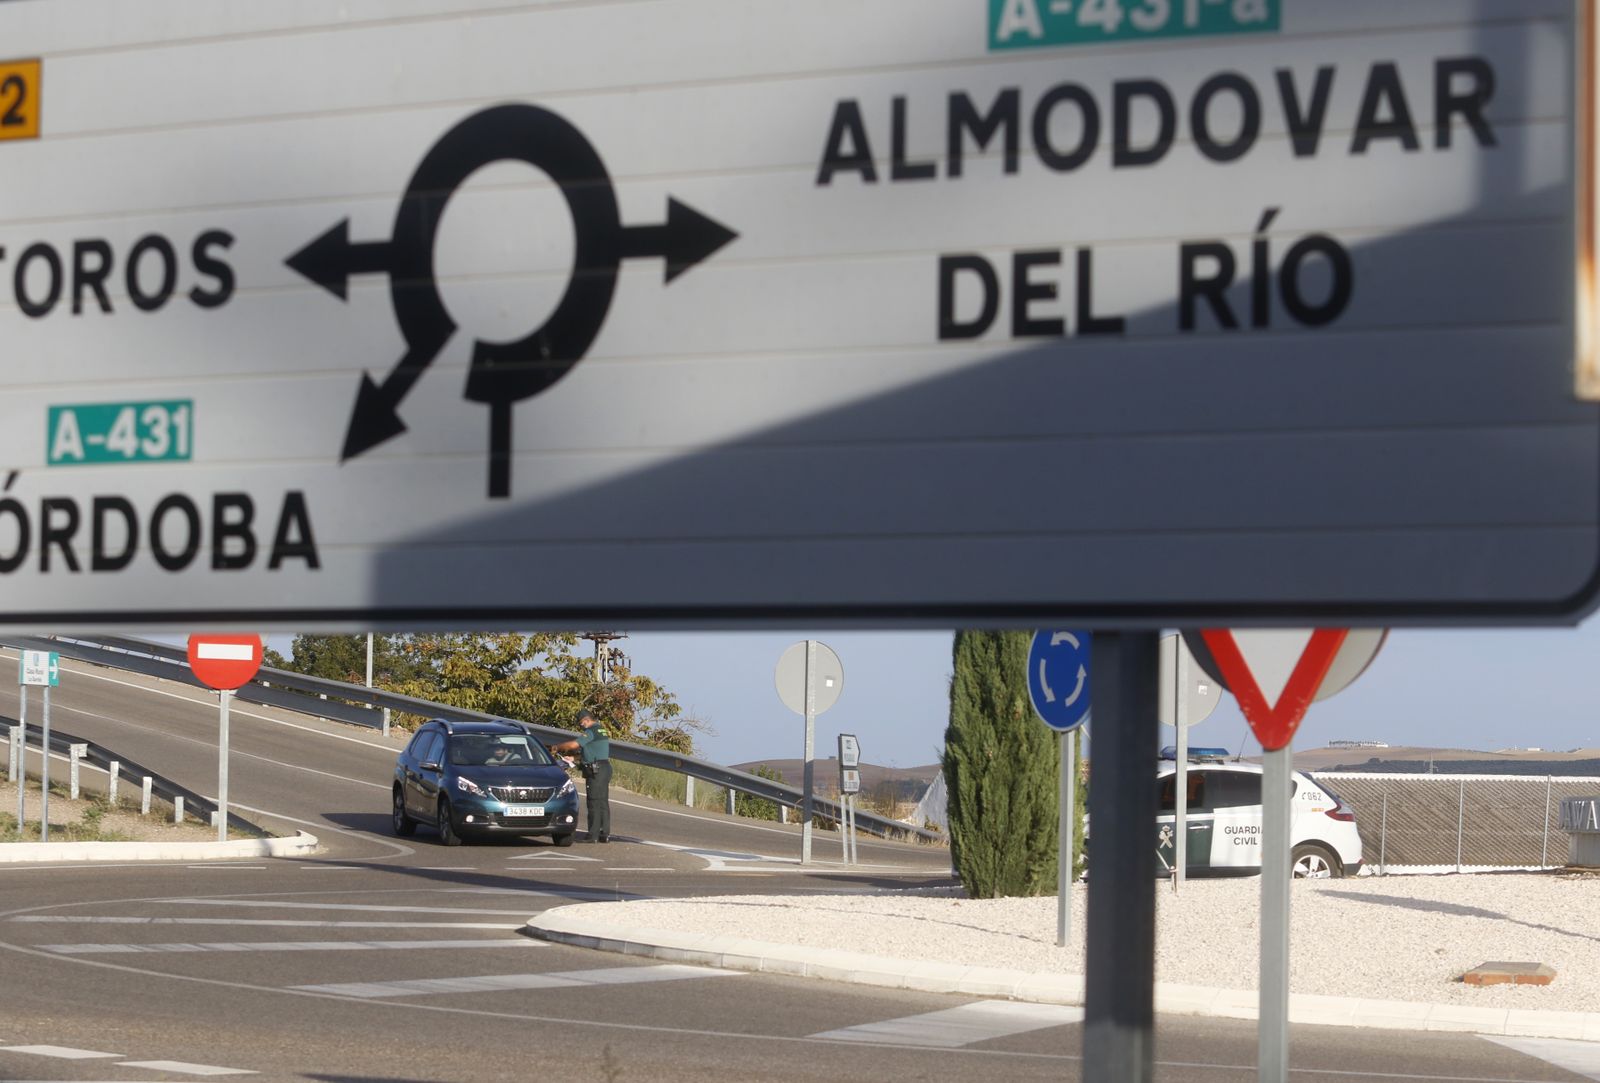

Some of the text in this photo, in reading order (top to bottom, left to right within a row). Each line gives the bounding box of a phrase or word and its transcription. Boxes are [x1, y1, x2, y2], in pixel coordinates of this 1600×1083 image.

[815, 56, 1498, 187] ALMODOVAR
[0, 228, 237, 319] OROS
[938, 207, 1353, 341] DEL RÍO
[50, 404, 192, 460] A-431
[509, 807, 528, 815] 3438
[1224, 825, 1263, 835] GUARDI
[1233, 836, 1258, 846] CIVIL
